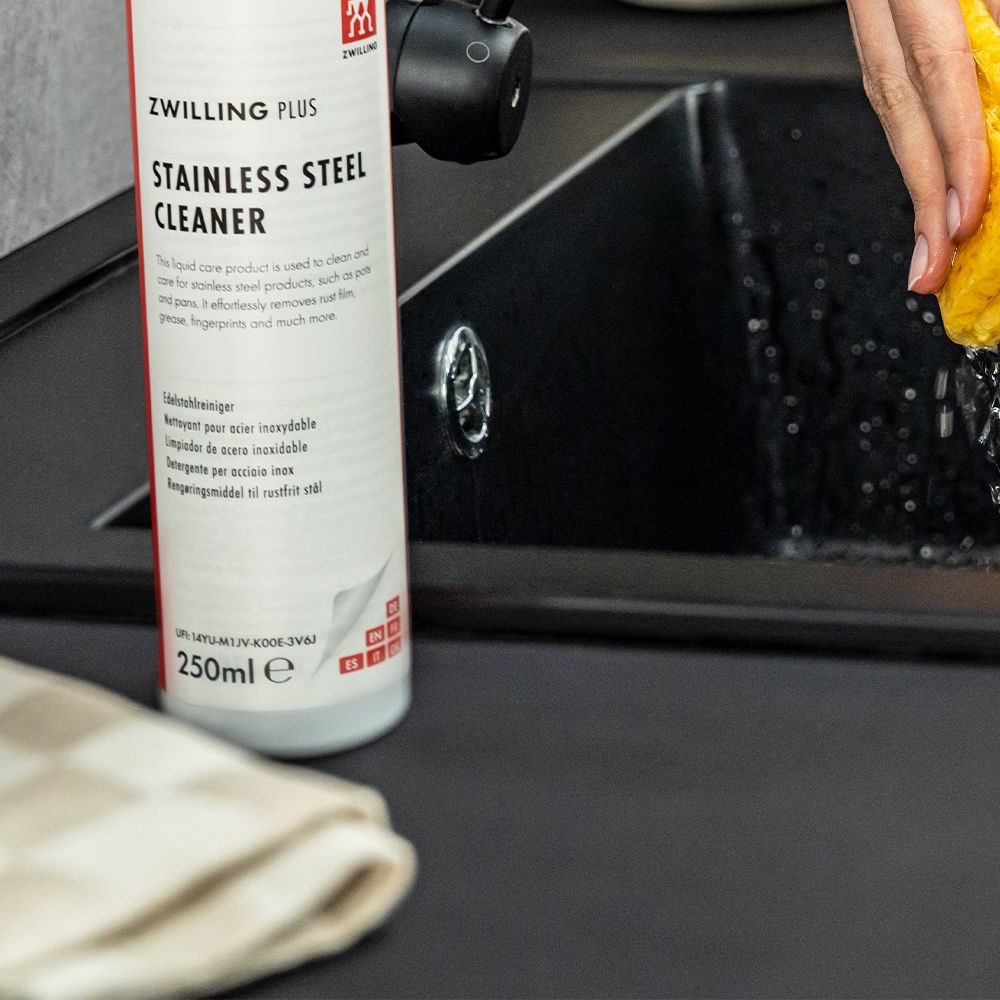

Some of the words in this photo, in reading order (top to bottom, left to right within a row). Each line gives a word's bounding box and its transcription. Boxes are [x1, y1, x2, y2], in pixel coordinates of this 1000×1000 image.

[342, 41, 378, 59] ZWILLING
[149, 97, 268, 121] ZWILLING
[278, 97, 317, 120] PLUS
[152, 160, 289, 194] STAINLESS
[302, 151, 366, 189] STEEL
[154, 202, 266, 234] CLEANER
[156, 254, 170, 268] This
[172, 257, 196, 272] liquid
[199, 263, 222, 274] care
[226, 262, 269, 276] product
[272, 262, 280, 272] is
[284, 257, 310, 272] used
[313, 258, 323, 268] to
[326, 253, 352, 266] clean
[354, 244, 370, 260] and
[157, 276, 174, 287] care
[176, 275, 188, 288] for
[191, 280, 232, 292] stainless
[235, 280, 260, 292] steel
[264, 278, 315, 294] products,
[318, 271, 340, 286] such
[342, 272, 353, 281] as
[158, 293, 173, 305] and
[175, 298, 200, 309] pans.
[202, 298, 208, 309] It
[210, 298, 267, 313] effortlessly
[270, 297, 317, 310] removes
[319, 292, 336, 304] rust
[159, 312, 188, 326] grease,
[191, 315, 247, 331] fingerprints
[250, 316, 272, 328] and
[276, 314, 306, 328] much
[309, 312, 338, 324] more.
[163, 391, 235, 414] Edelstahlreiniger
[164, 414, 201, 432] Nettoyant
[204, 423, 226, 434] pour
[230, 423, 254, 434] acier
[258, 417, 317, 436] inoxydable
[165, 434, 203, 452] Limpiador
[206, 441, 217, 454] de
[221, 445, 248, 456] acero
[252, 440, 308, 456] inoxidable
[166, 456, 209, 475] Detergente
[212, 466, 227, 478] per
[231, 466, 267, 477] acciaio
[271, 464, 294, 476] inox
[167, 477, 244, 499] Rengøringsmiddel
[248, 486, 259, 498] til
[263, 482, 300, 498] rustfrit
[304, 480, 322, 495] stål
[177, 651, 254, 684] 250ml
[345, 658, 359, 671] ES
